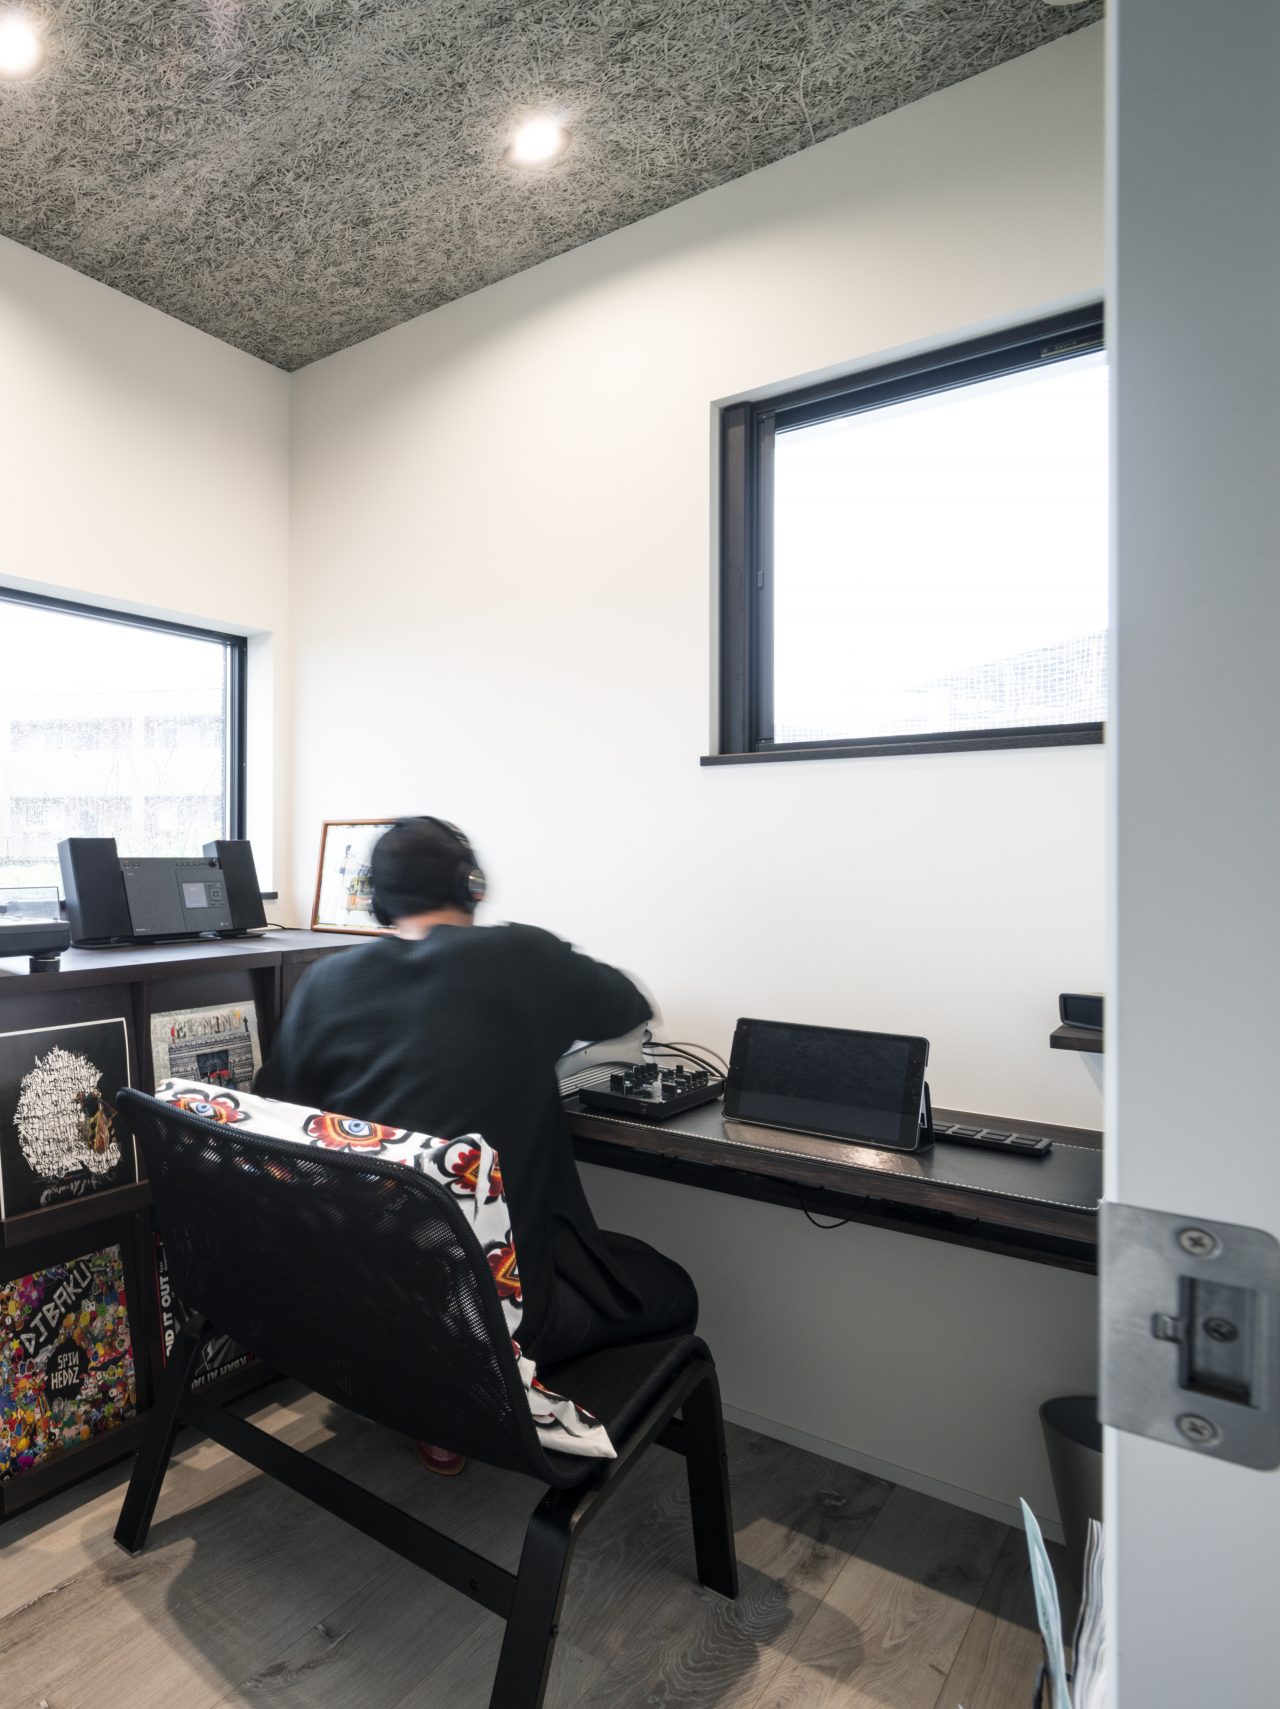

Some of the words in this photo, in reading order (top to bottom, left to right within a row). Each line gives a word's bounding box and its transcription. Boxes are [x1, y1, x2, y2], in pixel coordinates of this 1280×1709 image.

[159, 1275, 172, 1308] OUT
[163, 1312, 174, 1327] IT
[57, 1350, 79, 1369] SPIN
[51, 1366, 81, 1391] HEDDZ
